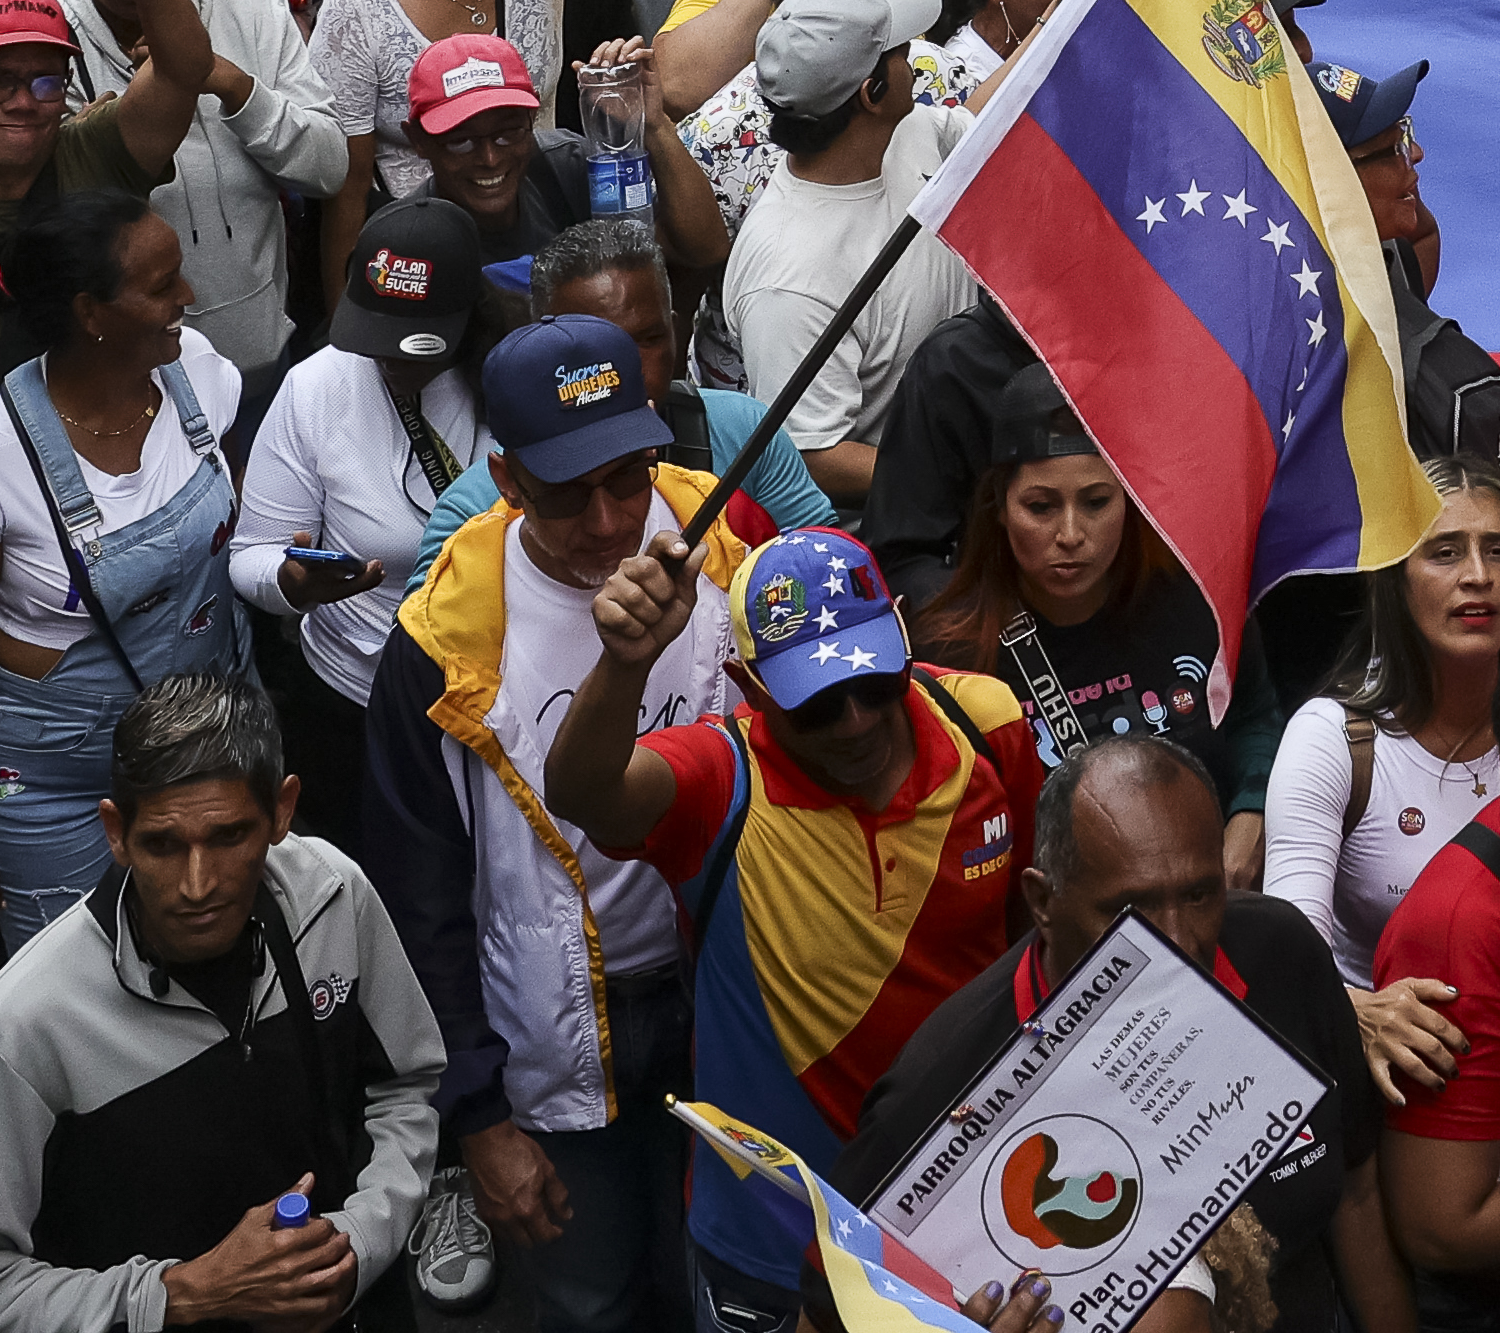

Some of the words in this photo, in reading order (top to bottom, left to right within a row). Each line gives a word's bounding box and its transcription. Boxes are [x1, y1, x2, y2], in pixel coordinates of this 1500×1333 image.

[385, 276, 428, 295] SUCRE
[392, 260, 428, 275] PLAN
[555, 364, 599, 391] Sucre
[575, 386, 612, 408] Alcalde
[983, 812, 1008, 845] MI
[964, 863, 980, 881] ES
[1090, 1049, 1112, 1072] LAS
[1109, 1009, 1146, 1053] DEMAS
[1105, 1006, 1173, 1083] MUJERES
[896, 1085, 1016, 1218] PARROQUIA
[1011, 953, 1133, 1096] ALTAGRACIA
[1119, 1071, 1139, 1095] SON
[1138, 1049, 1160, 1073] TUS
[1140, 1097, 1157, 1116] NO
[1155, 1076, 1177, 1100] TUS
[1269, 1160, 1299, 1183] TOMMY
[1088, 1100, 1304, 1333] artoHumanizado
[1069, 1269, 1126, 1326] Plan
